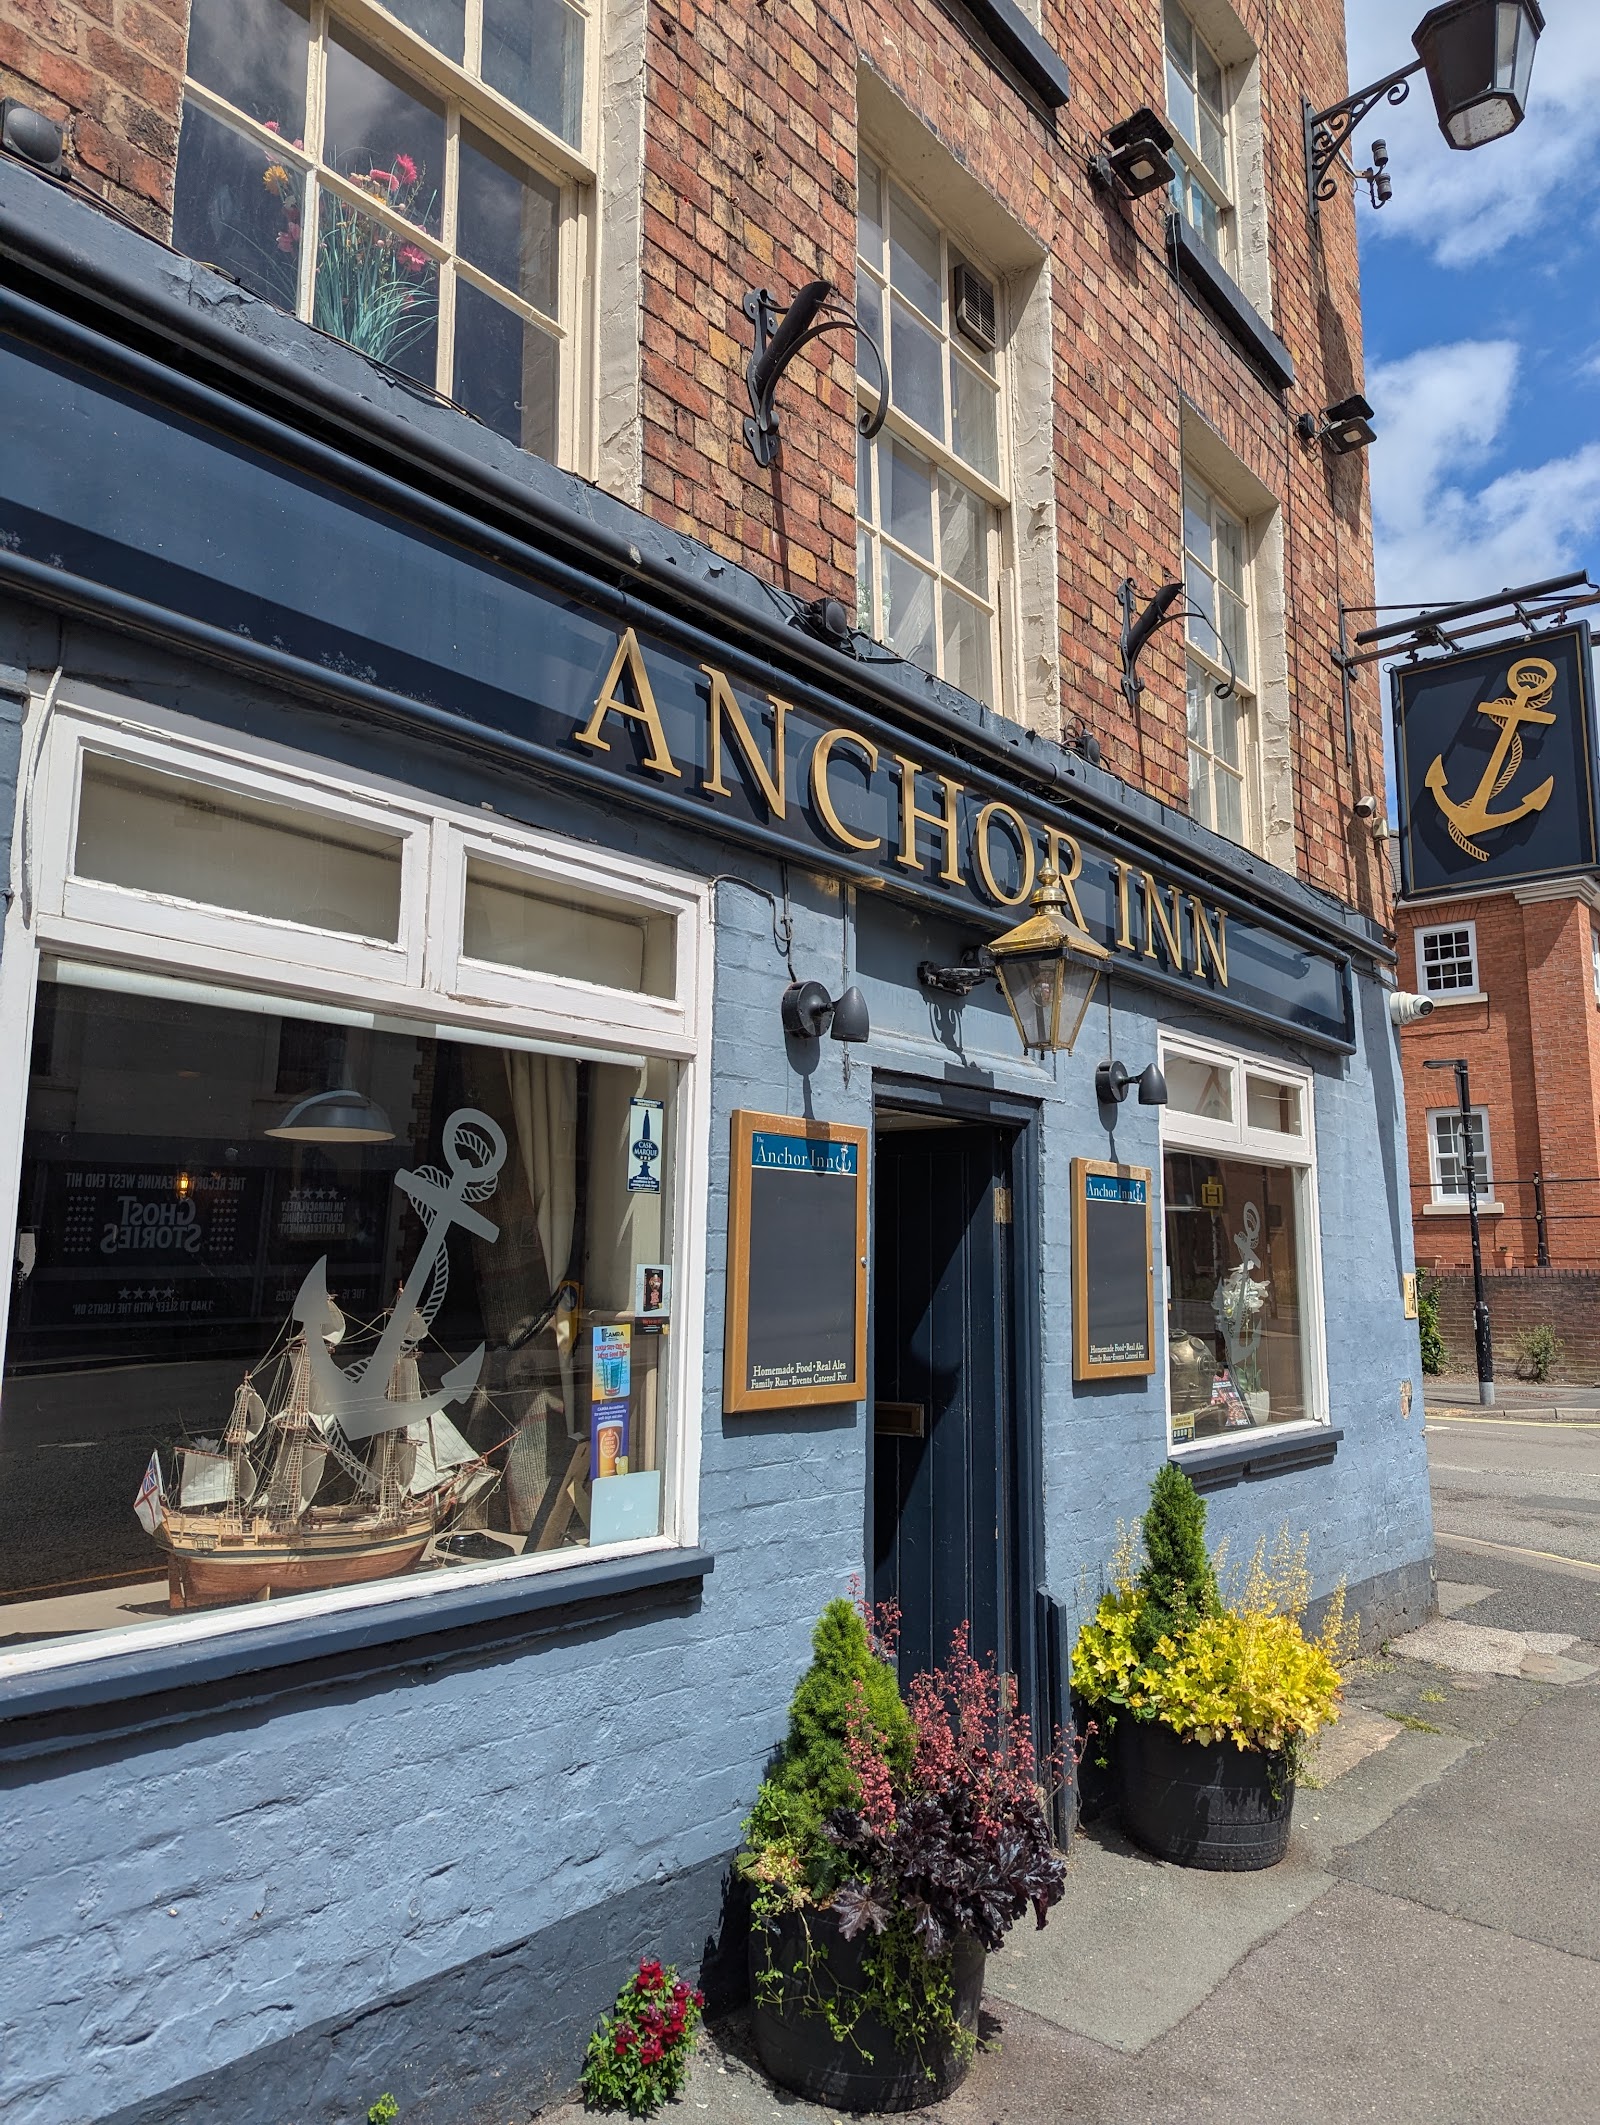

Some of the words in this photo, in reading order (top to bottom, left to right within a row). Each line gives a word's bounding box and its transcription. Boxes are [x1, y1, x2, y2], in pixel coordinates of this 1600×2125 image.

[573, 627, 1090, 934] ANCHOR
[1113, 857, 1229, 988] INN
[634, 1148, 658, 1157] MARQUE
[638, 1142, 653, 1150] CASK
[755, 1144, 808, 1166] Anchor
[810, 1149, 834, 1169] Inn
[1087, 1182, 1118, 1198] Anchor
[1118, 1184, 1133, 1199] Inn
[753, 1364, 795, 1377] Homemade
[796, 1362, 812, 1373] Food
[816, 1360, 831, 1372] Real
[832, 1359, 846, 1370] Ales
[751, 1378, 774, 1390] Family
[813, 1372, 836, 1384] Catered
[837, 1371, 847, 1381] For
